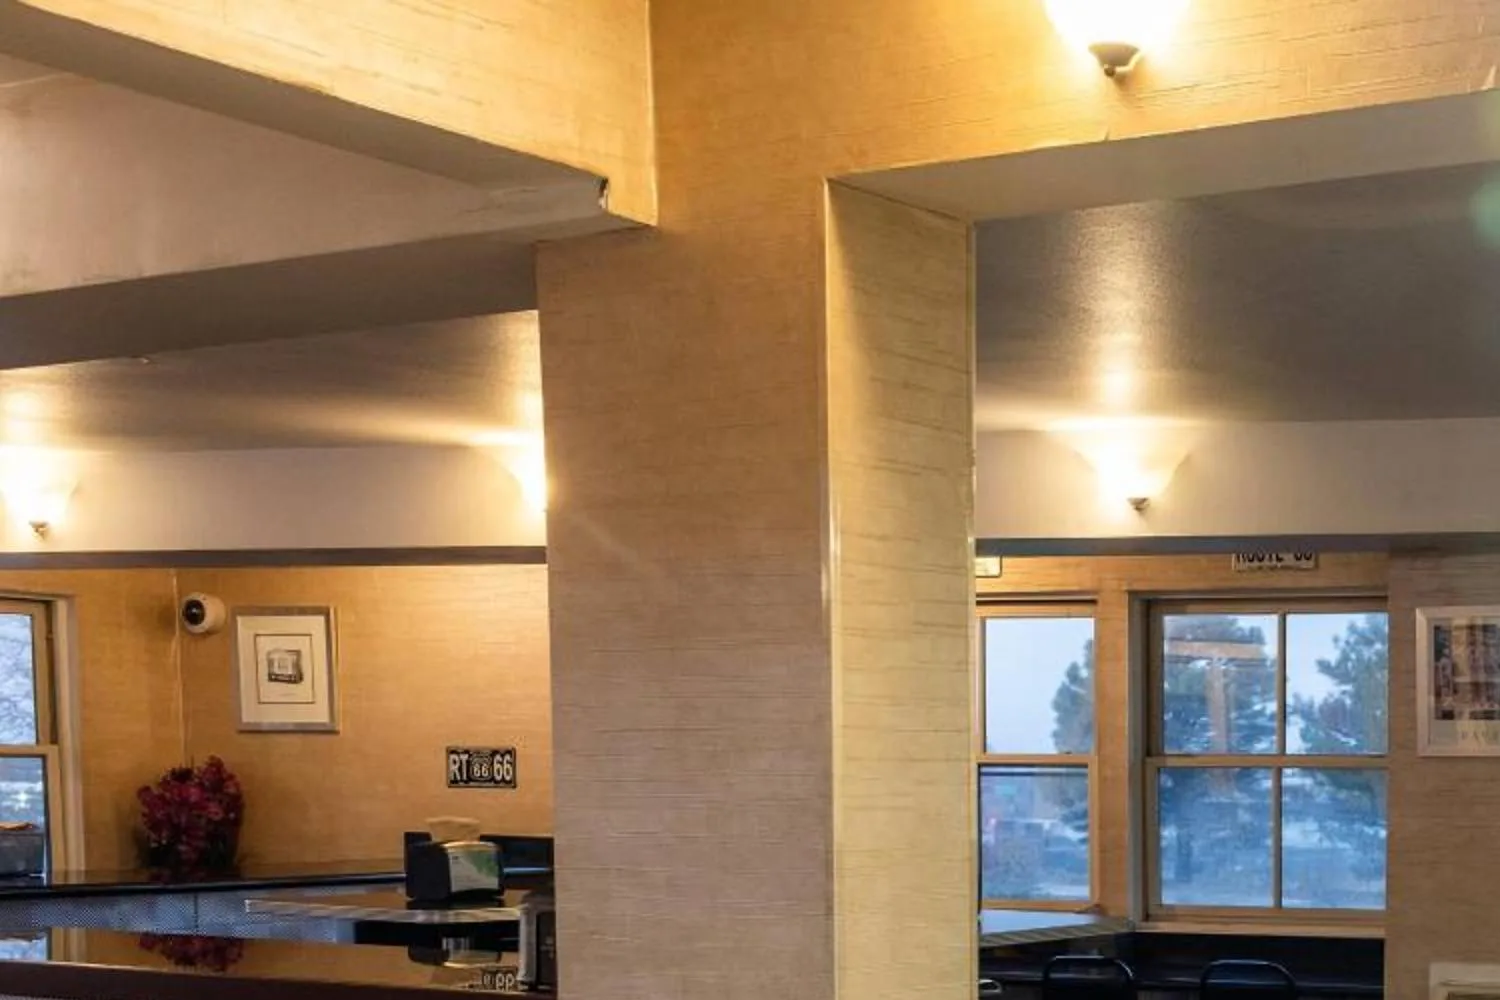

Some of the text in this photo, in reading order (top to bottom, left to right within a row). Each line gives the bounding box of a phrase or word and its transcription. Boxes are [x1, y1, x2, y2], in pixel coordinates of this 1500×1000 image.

[449, 754, 513, 781] RT 66
[473, 763, 489, 777] 66
